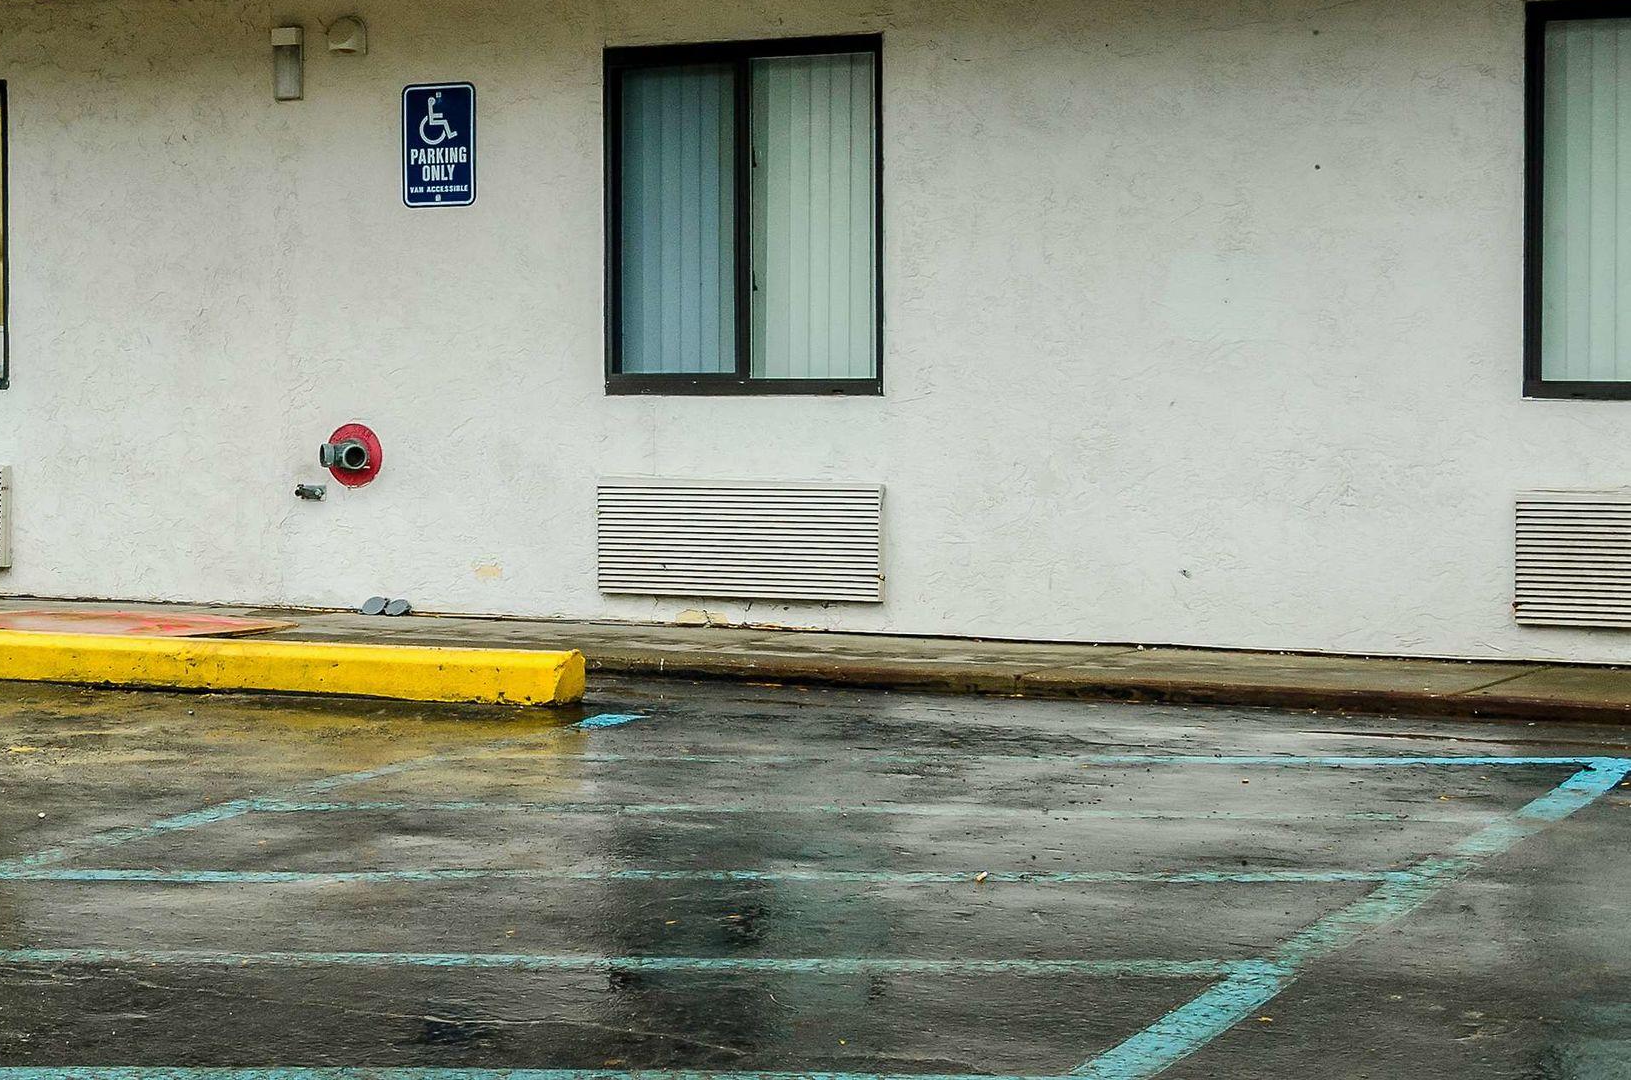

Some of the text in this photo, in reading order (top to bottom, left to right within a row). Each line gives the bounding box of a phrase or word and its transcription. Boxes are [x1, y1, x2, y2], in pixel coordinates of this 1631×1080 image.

[410, 146, 467, 165] PARKING
[422, 165, 455, 181] ONLY
[410, 184, 468, 194] VAN ACCESSIBLE
